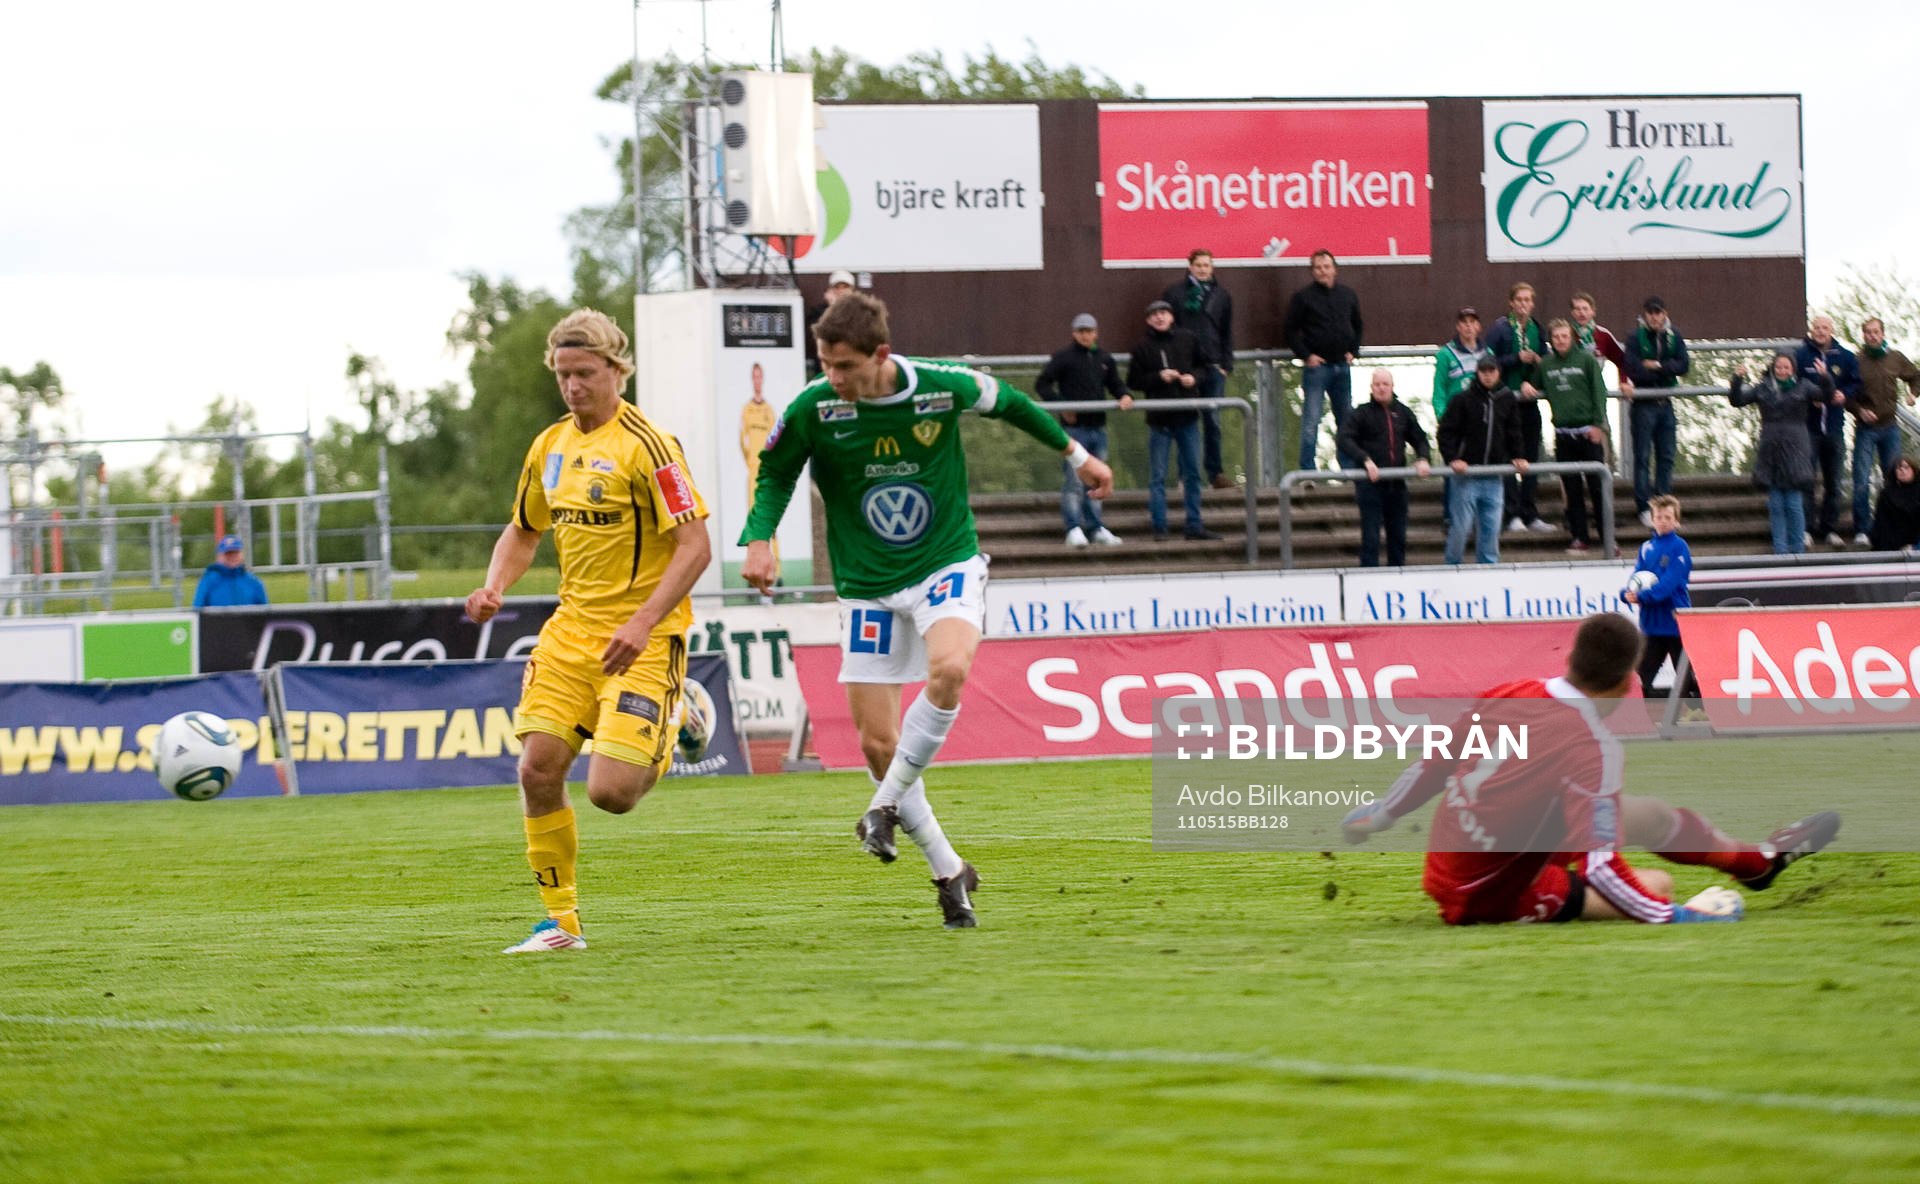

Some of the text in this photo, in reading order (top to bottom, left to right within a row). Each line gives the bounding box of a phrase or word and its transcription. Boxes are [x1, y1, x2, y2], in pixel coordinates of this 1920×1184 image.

[875, 179, 1025, 218] bjäre kraft
[1116, 159, 1416, 212] Skånetrafiken
[1494, 119, 1791, 248] Erikslund
[1002, 596, 1326, 633] AB Kurt Lundström
[1360, 591, 1406, 622] AB
[1420, 588, 1489, 620] Kurt
[1026, 642, 1431, 742] Scandic
[1720, 621, 1920, 716] Ade
